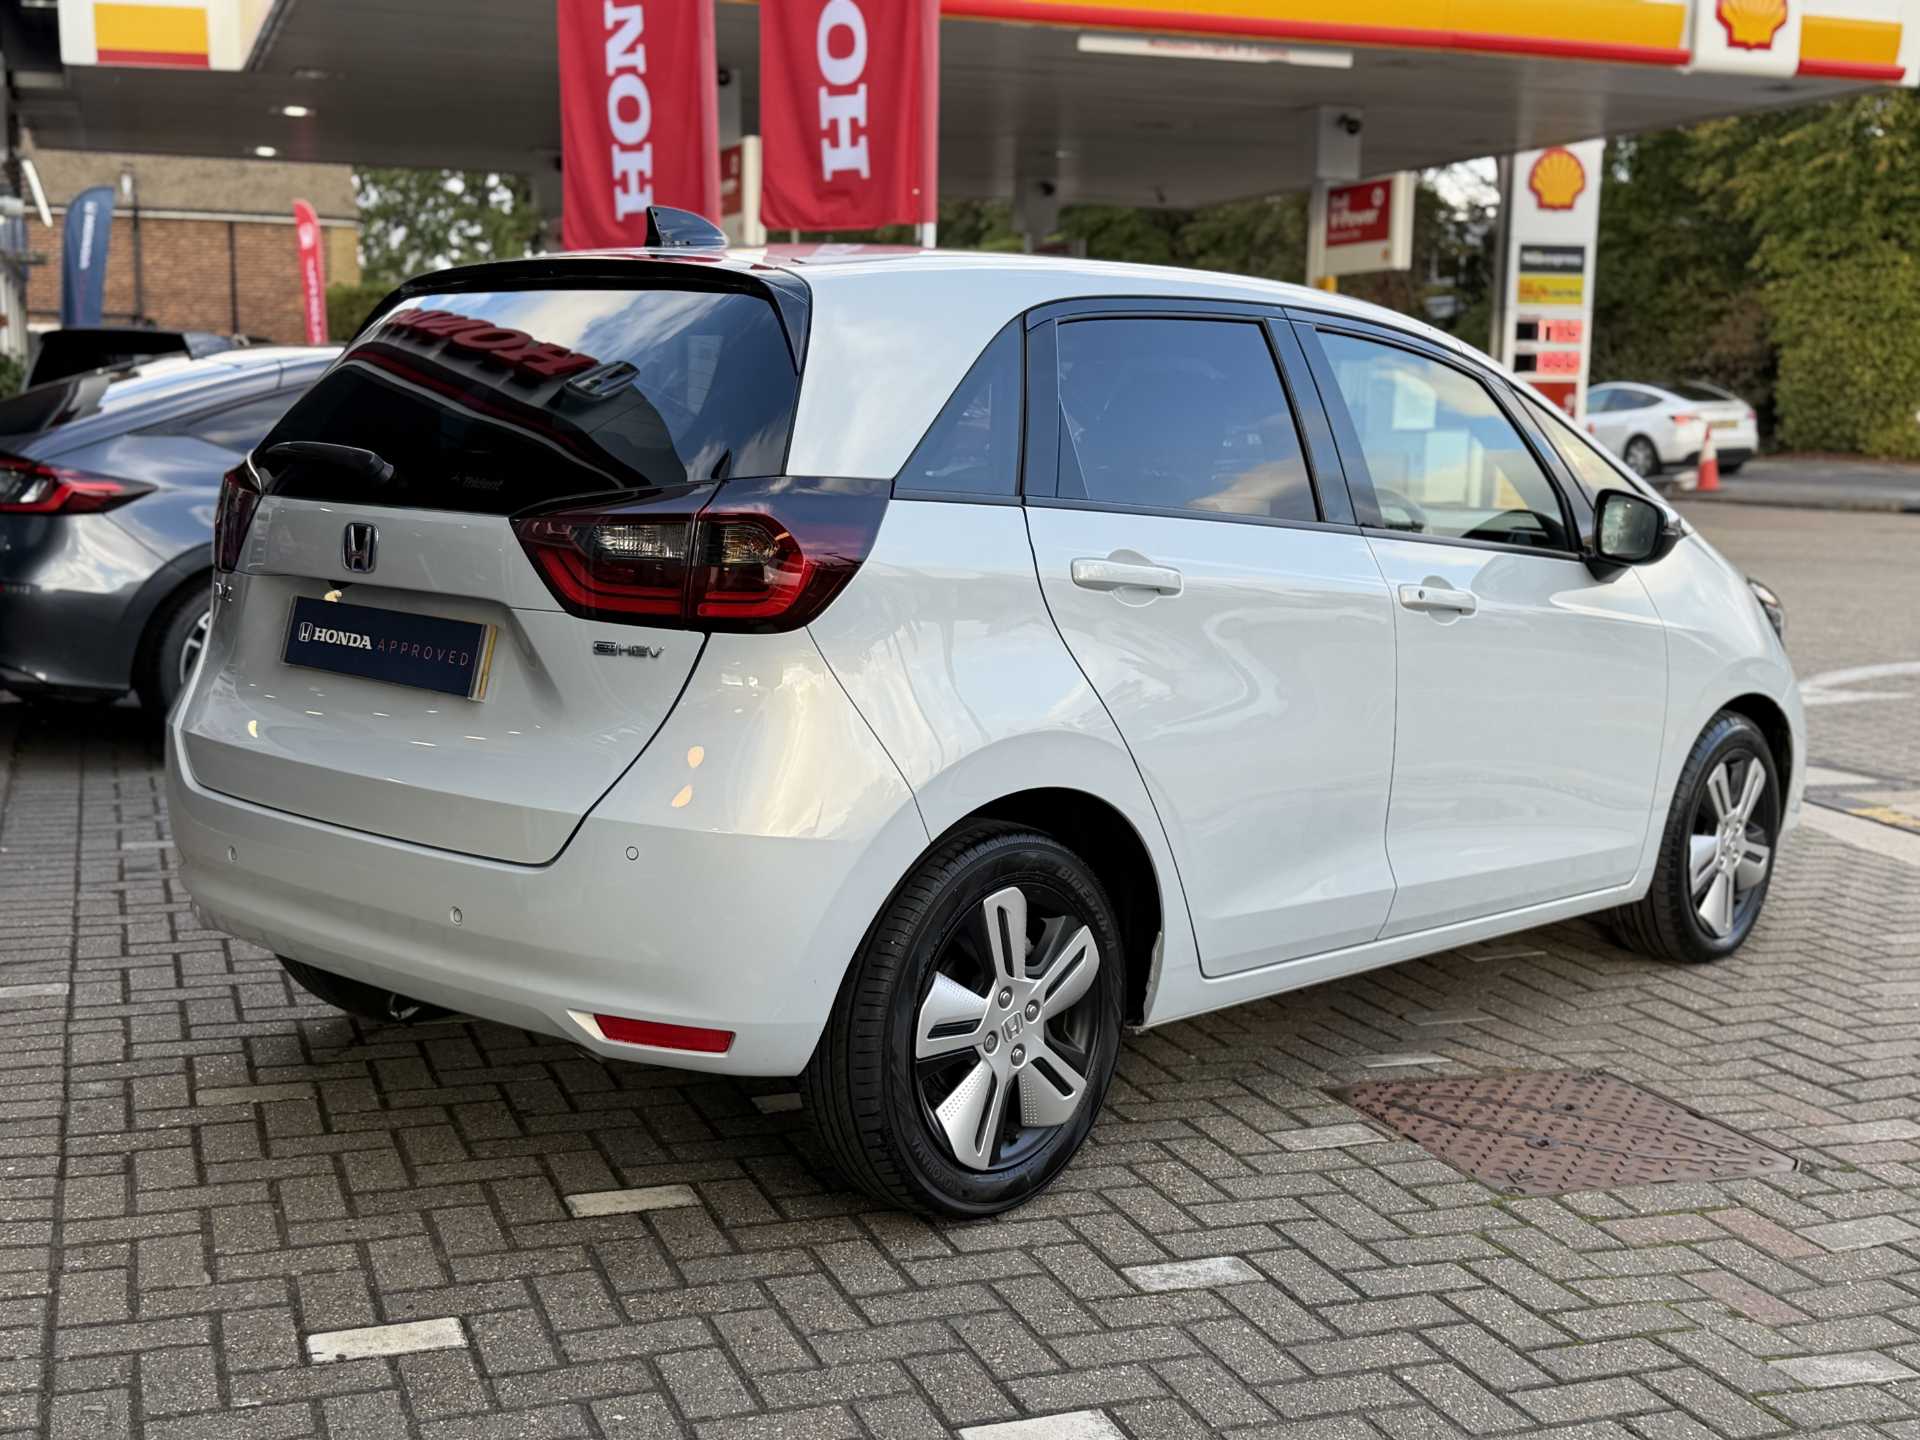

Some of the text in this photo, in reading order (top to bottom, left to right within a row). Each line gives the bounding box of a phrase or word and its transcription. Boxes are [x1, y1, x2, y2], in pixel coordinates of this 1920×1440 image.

[603, 0, 654, 221] HON
[816, 0, 871, 182] HO
[312, 626, 470, 668] HONDA APPROVED
